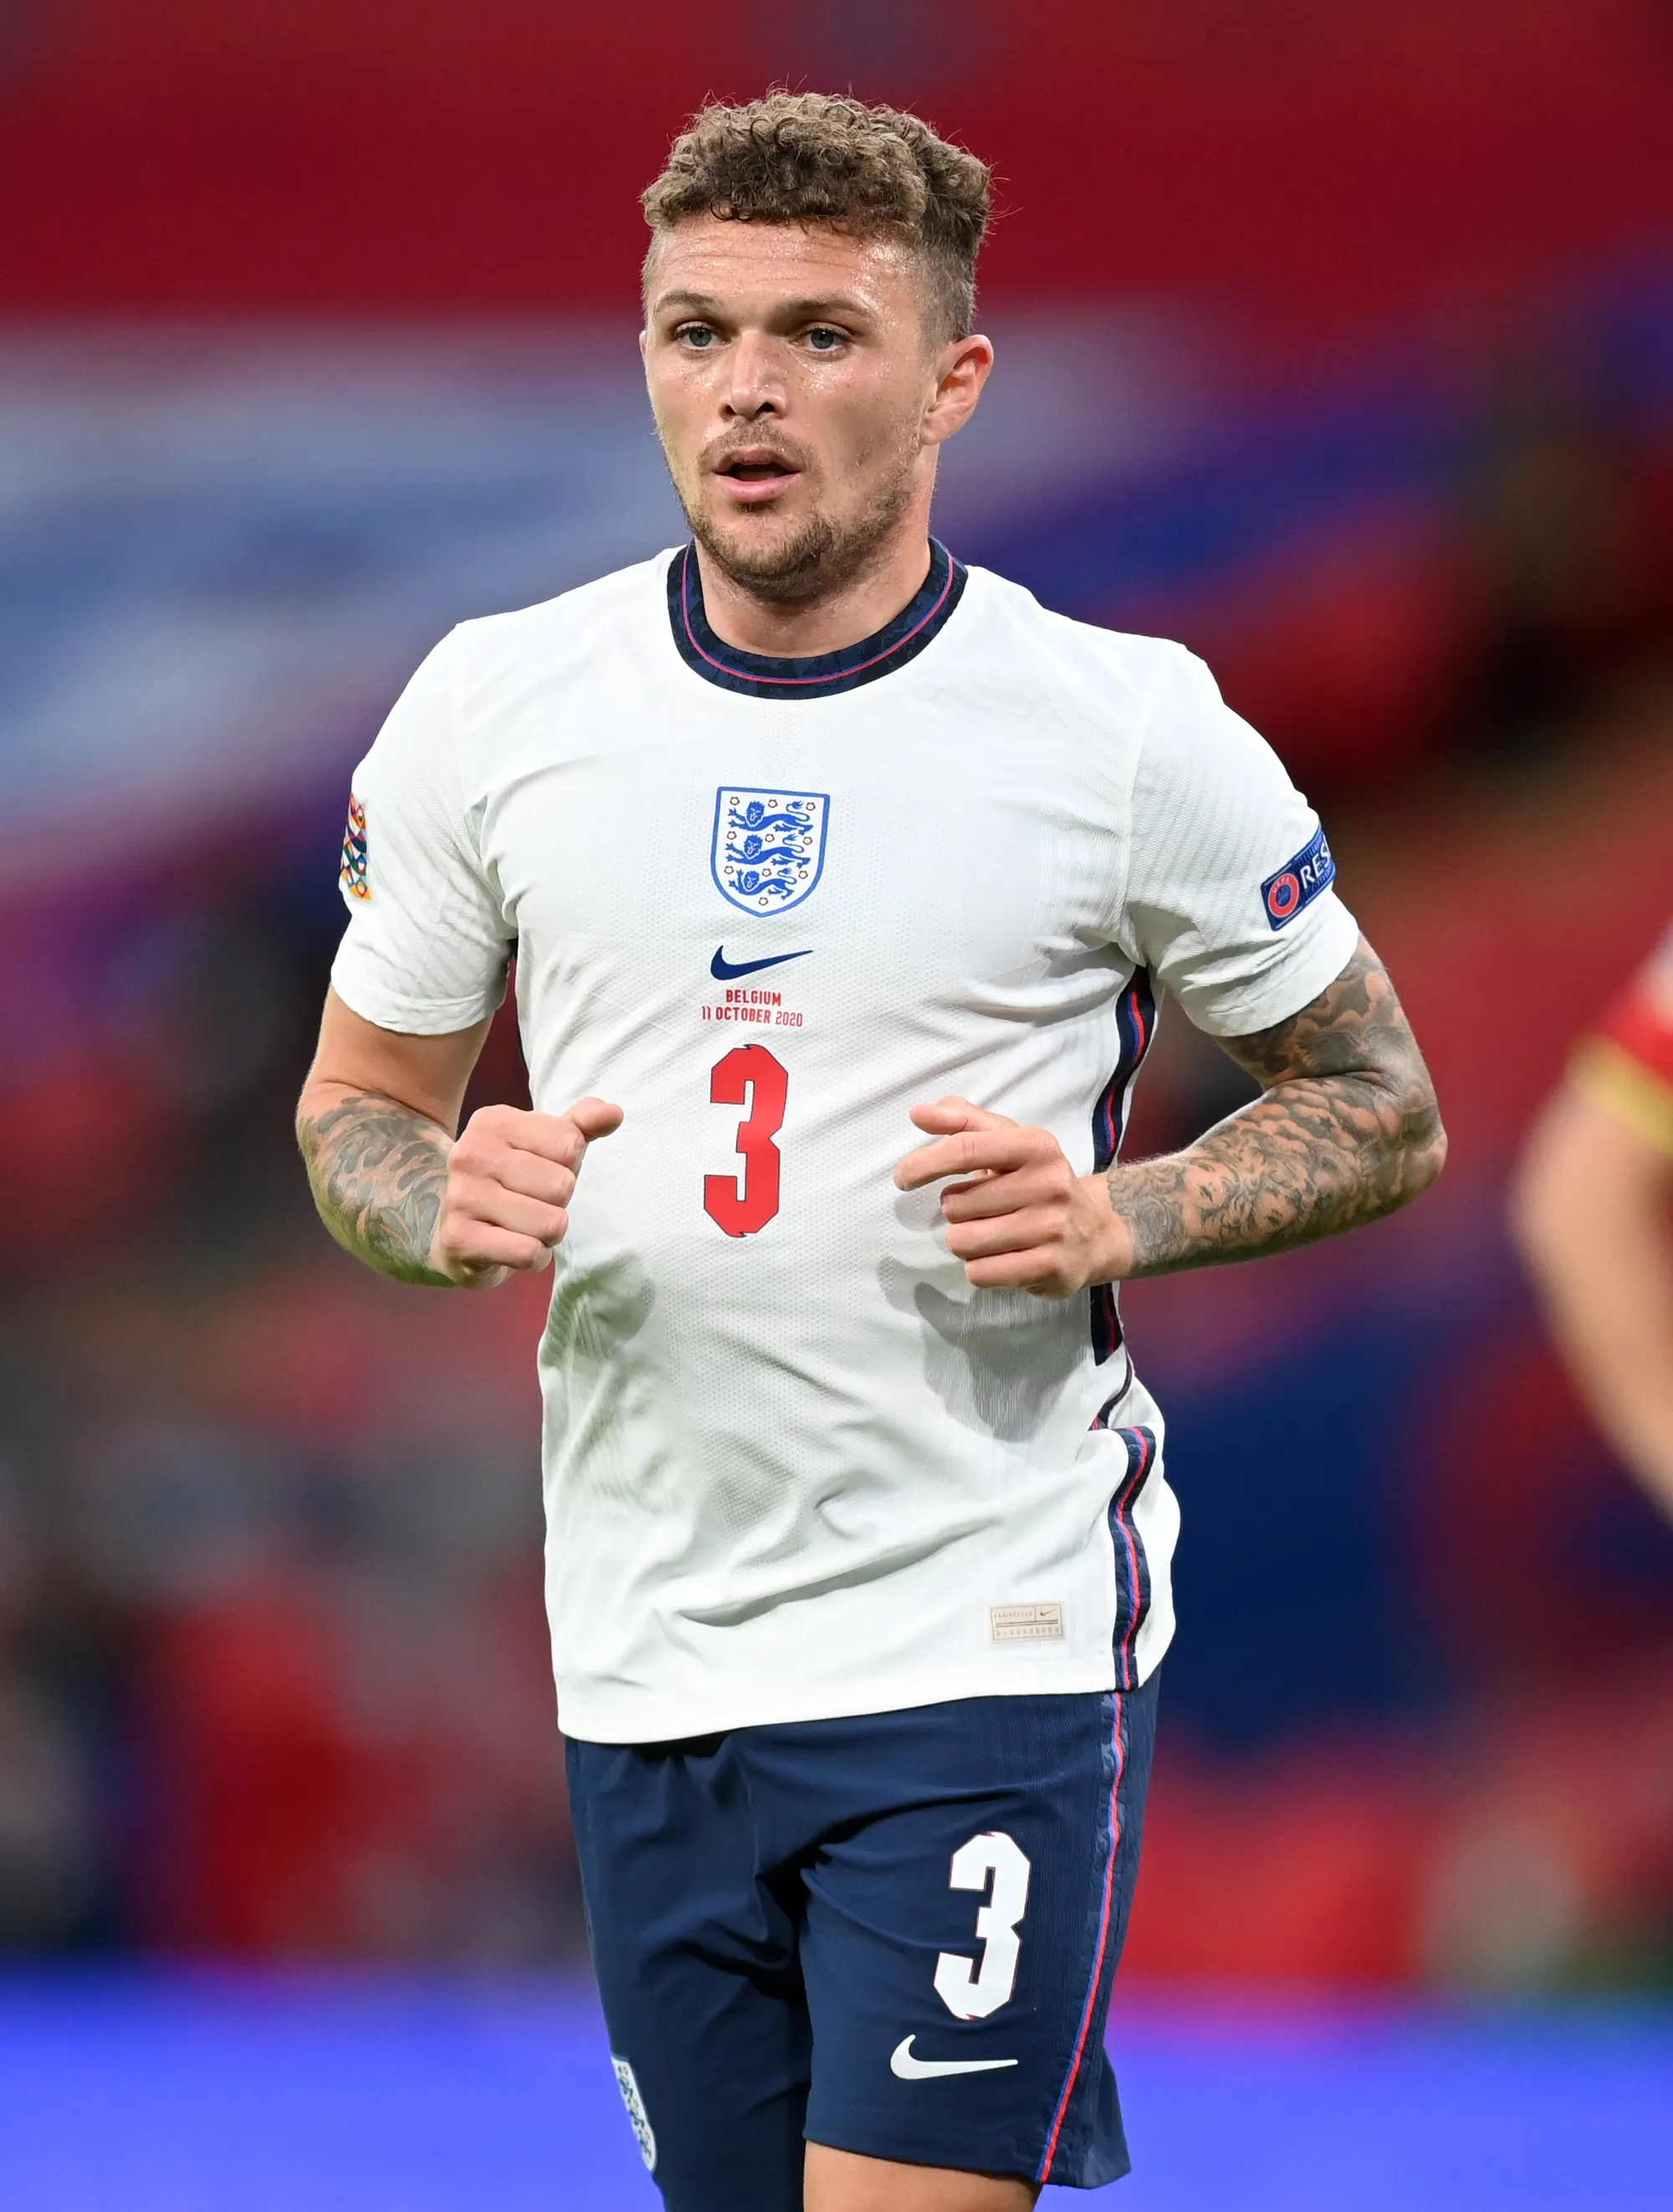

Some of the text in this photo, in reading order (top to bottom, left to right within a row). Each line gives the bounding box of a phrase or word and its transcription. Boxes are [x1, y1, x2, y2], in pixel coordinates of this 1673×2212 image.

[1300, 834, 1331, 889] RES
[701, 1006, 803, 1027] 11 OCTOBER 2020
[725, 989, 782, 1007] BELGIUM
[703, 1043, 789, 1237] 3
[933, 1831, 1031, 2020] 3
